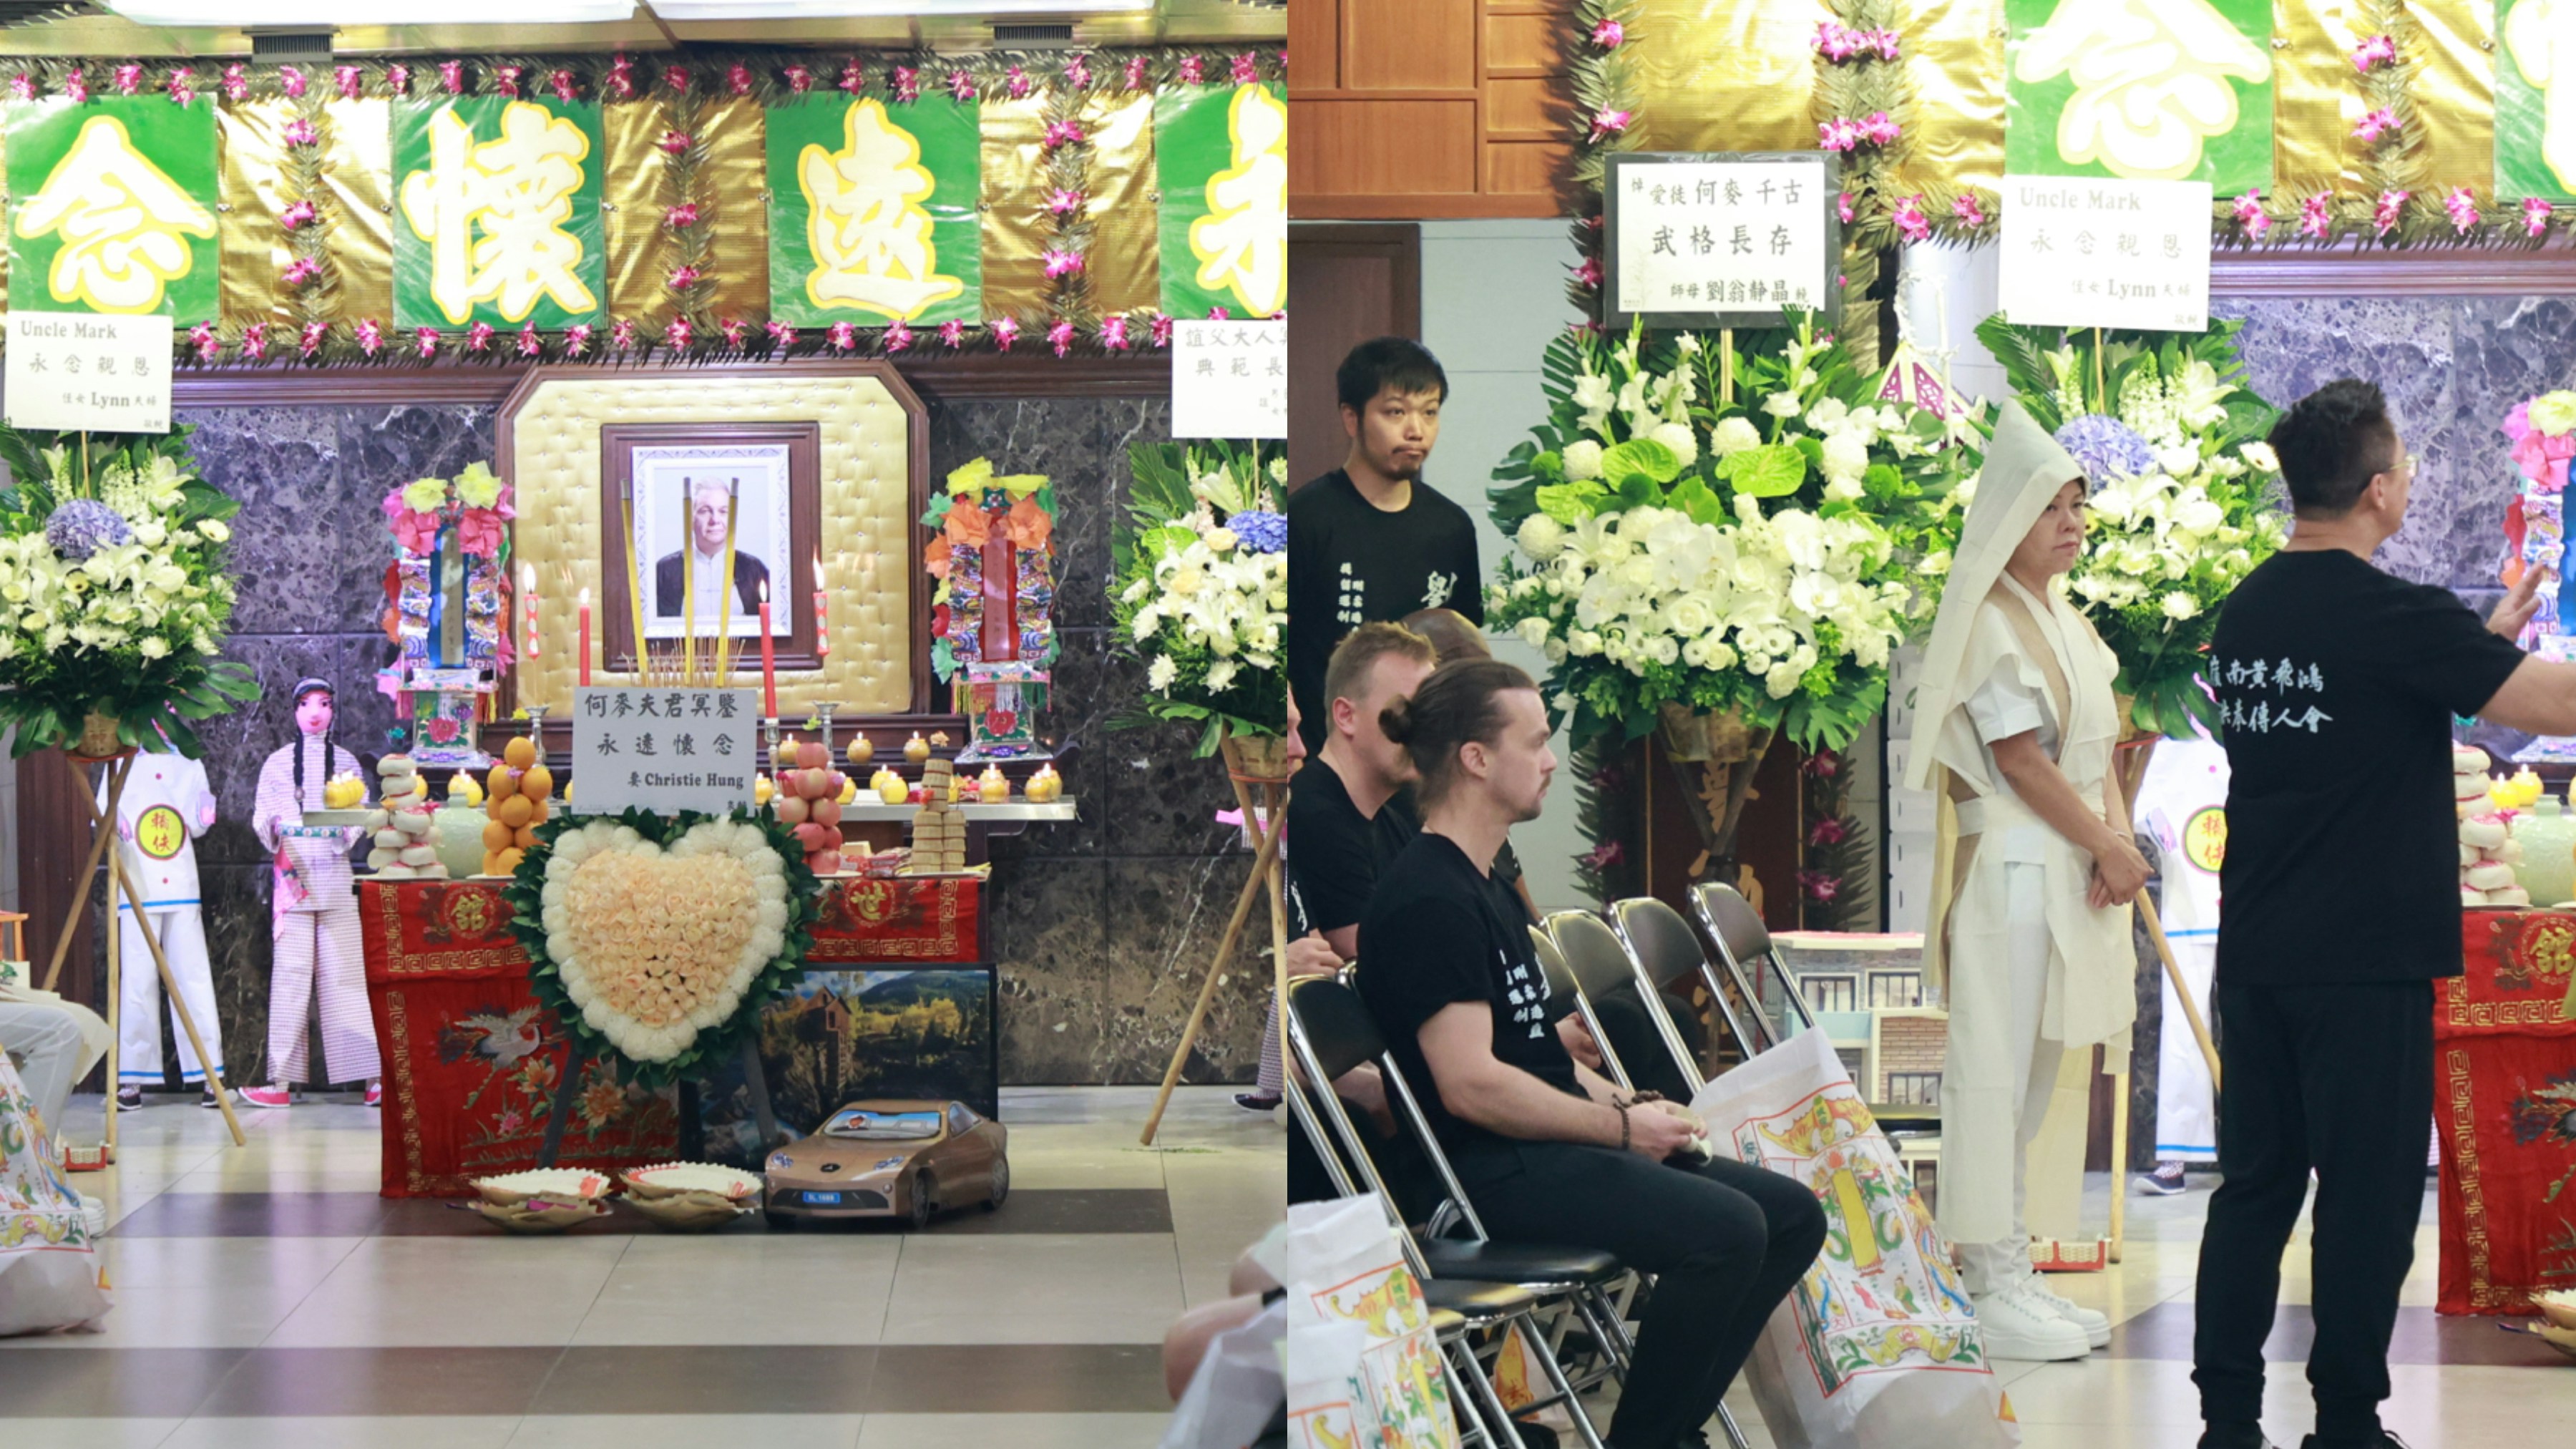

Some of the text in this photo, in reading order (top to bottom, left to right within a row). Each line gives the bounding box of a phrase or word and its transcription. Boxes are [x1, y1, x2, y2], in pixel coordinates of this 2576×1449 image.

[797, 97, 964, 319] 遠
[2020, 187, 2141, 210] Uncle Mark
[16, 114, 217, 315] 念
[400, 100, 598, 325] 懷
[1652, 224, 1792, 256] 武格長存
[2030, 228, 2182, 259] 永念親恩
[2107, 278, 2156, 300] Lynn
[21, 320, 117, 339] Uncle Mark
[29, 353, 150, 376] 永念親恩
[91, 391, 130, 409] Lynn
[597, 732, 734, 756] 永遠懷念
[645, 772, 701, 786] Christie
[706, 773, 744, 790] Hung
